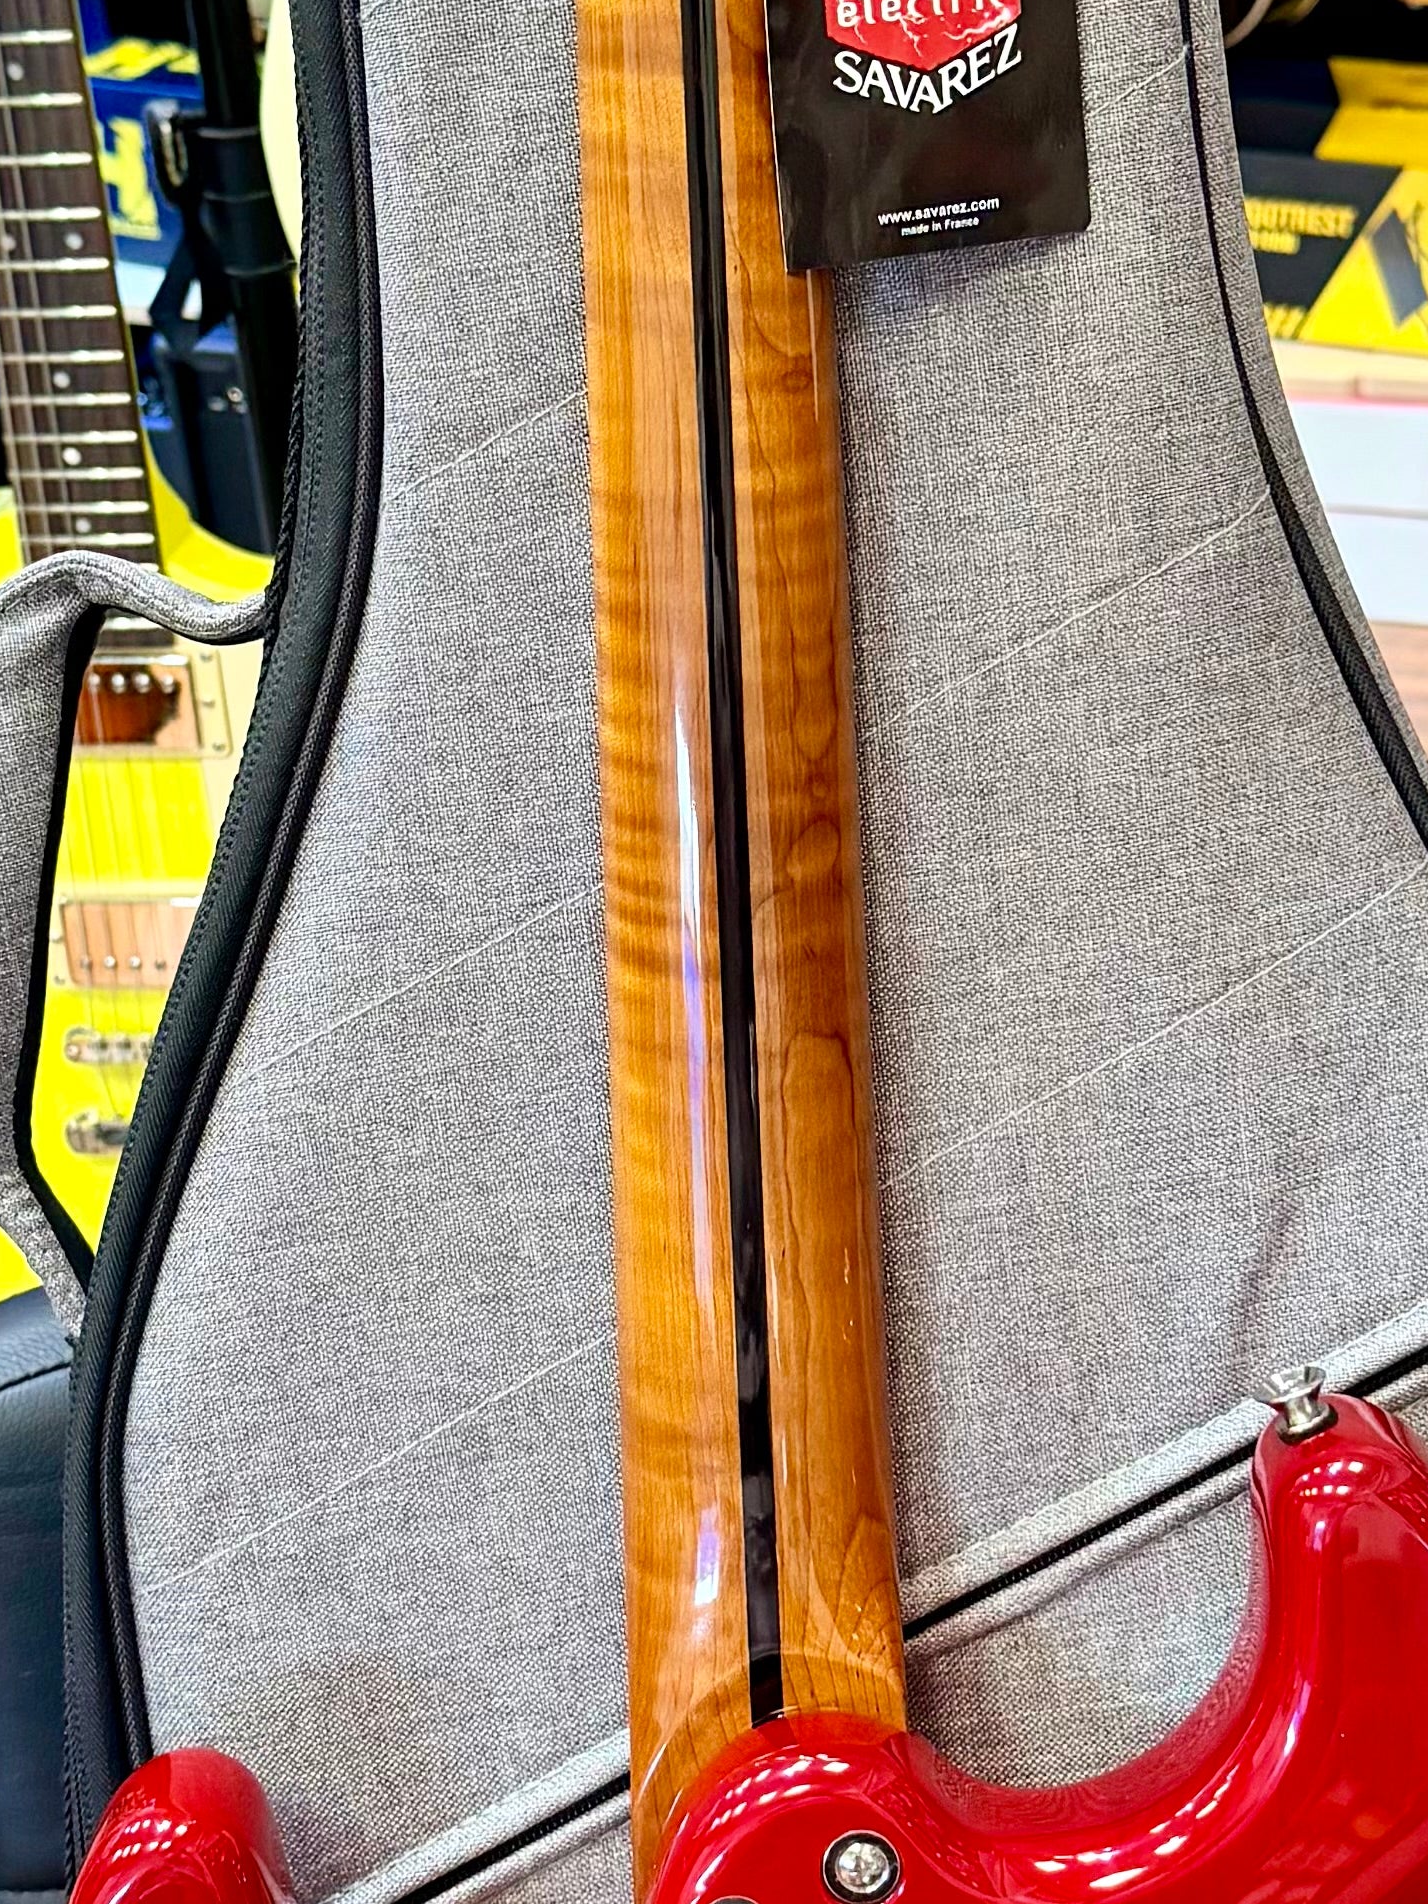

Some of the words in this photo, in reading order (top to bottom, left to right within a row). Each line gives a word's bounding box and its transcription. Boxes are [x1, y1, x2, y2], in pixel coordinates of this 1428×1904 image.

[833, 22, 1023, 115] SAVAREZ
[878, 197, 1000, 226] www.savarez.com
[901, 223, 929, 236] made
[932, 220, 942, 232] in
[945, 216, 980, 230] France
